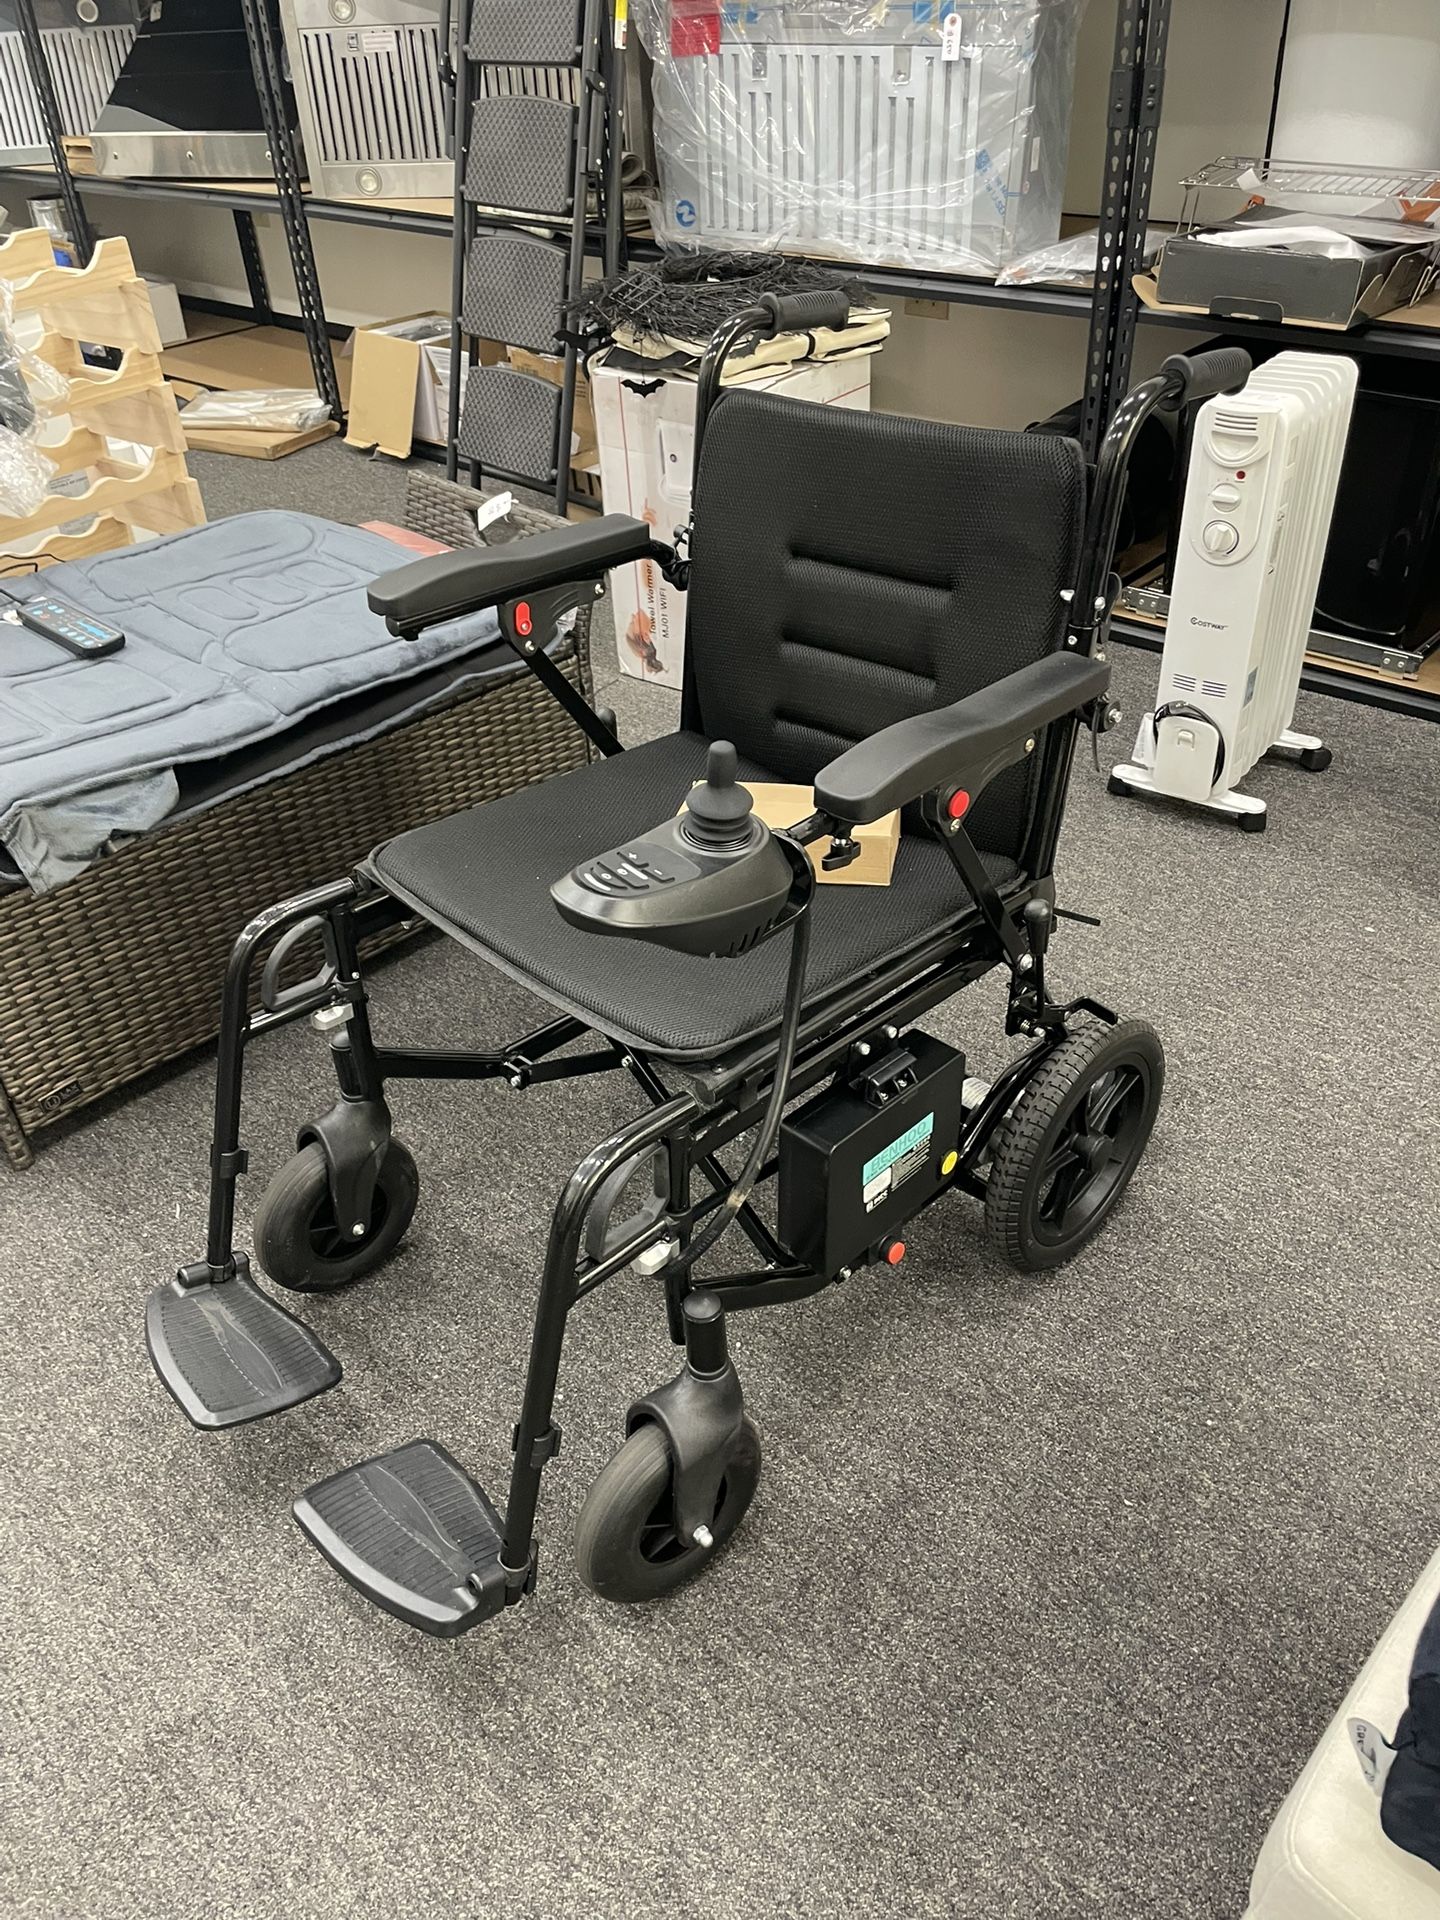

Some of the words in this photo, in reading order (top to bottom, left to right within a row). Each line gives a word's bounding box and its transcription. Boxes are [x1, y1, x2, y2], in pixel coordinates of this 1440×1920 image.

[646, 564, 655, 603] Warmer
[660, 587, 668, 610] WIFI
[1191, 617, 1228, 630] COSTWAY
